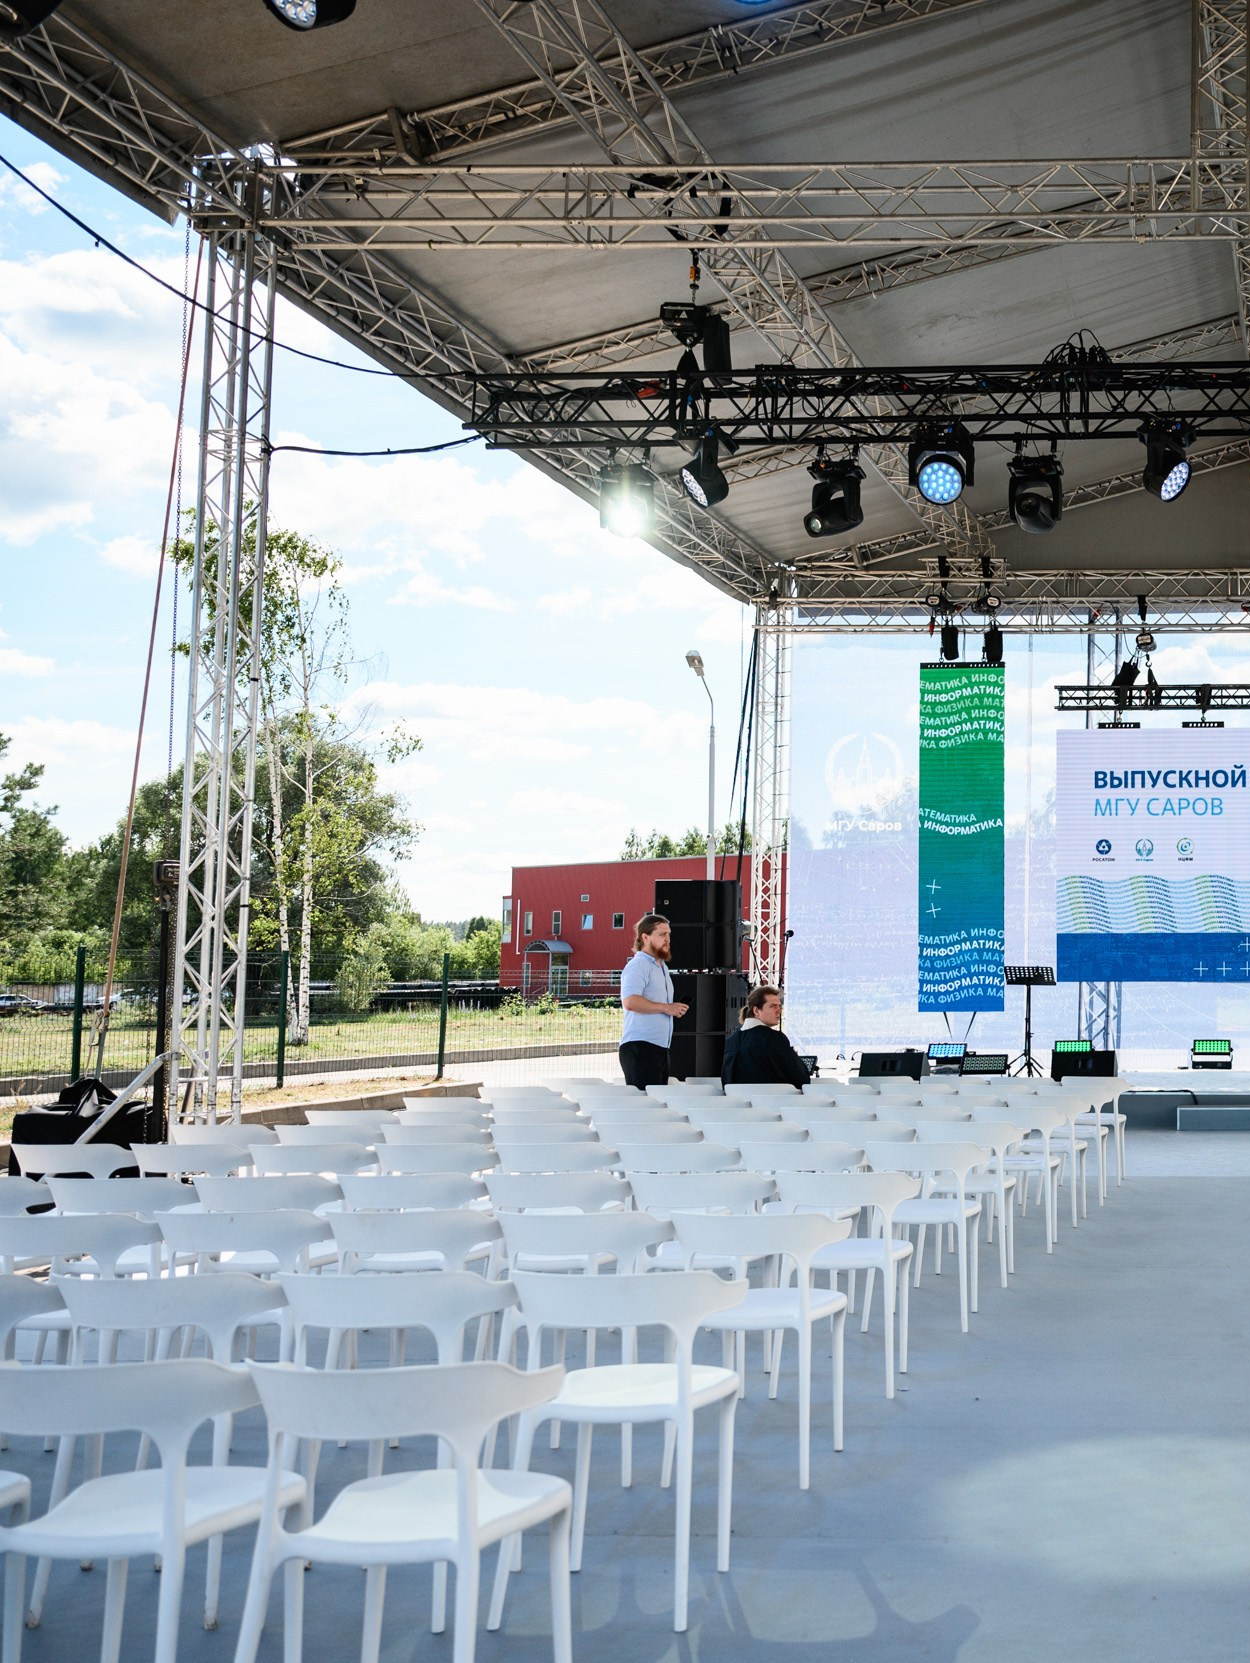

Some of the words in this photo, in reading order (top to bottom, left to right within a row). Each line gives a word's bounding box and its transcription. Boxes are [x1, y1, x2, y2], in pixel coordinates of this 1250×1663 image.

[935, 698, 980, 714] ФИЗИКА
[939, 732, 984, 748] ФИЗИКА
[1094, 764, 1247, 788] ВЫПУСКНОЙ
[1094, 798, 1140, 816] МГУ
[1146, 797, 1224, 816] САРОВ
[859, 820, 902, 834] Саров
[924, 818, 1004, 835] ИНФОРМАТИКА
[934, 952, 979, 968] ФИЗИКА
[938, 988, 984, 1004] ФИЗИКА
